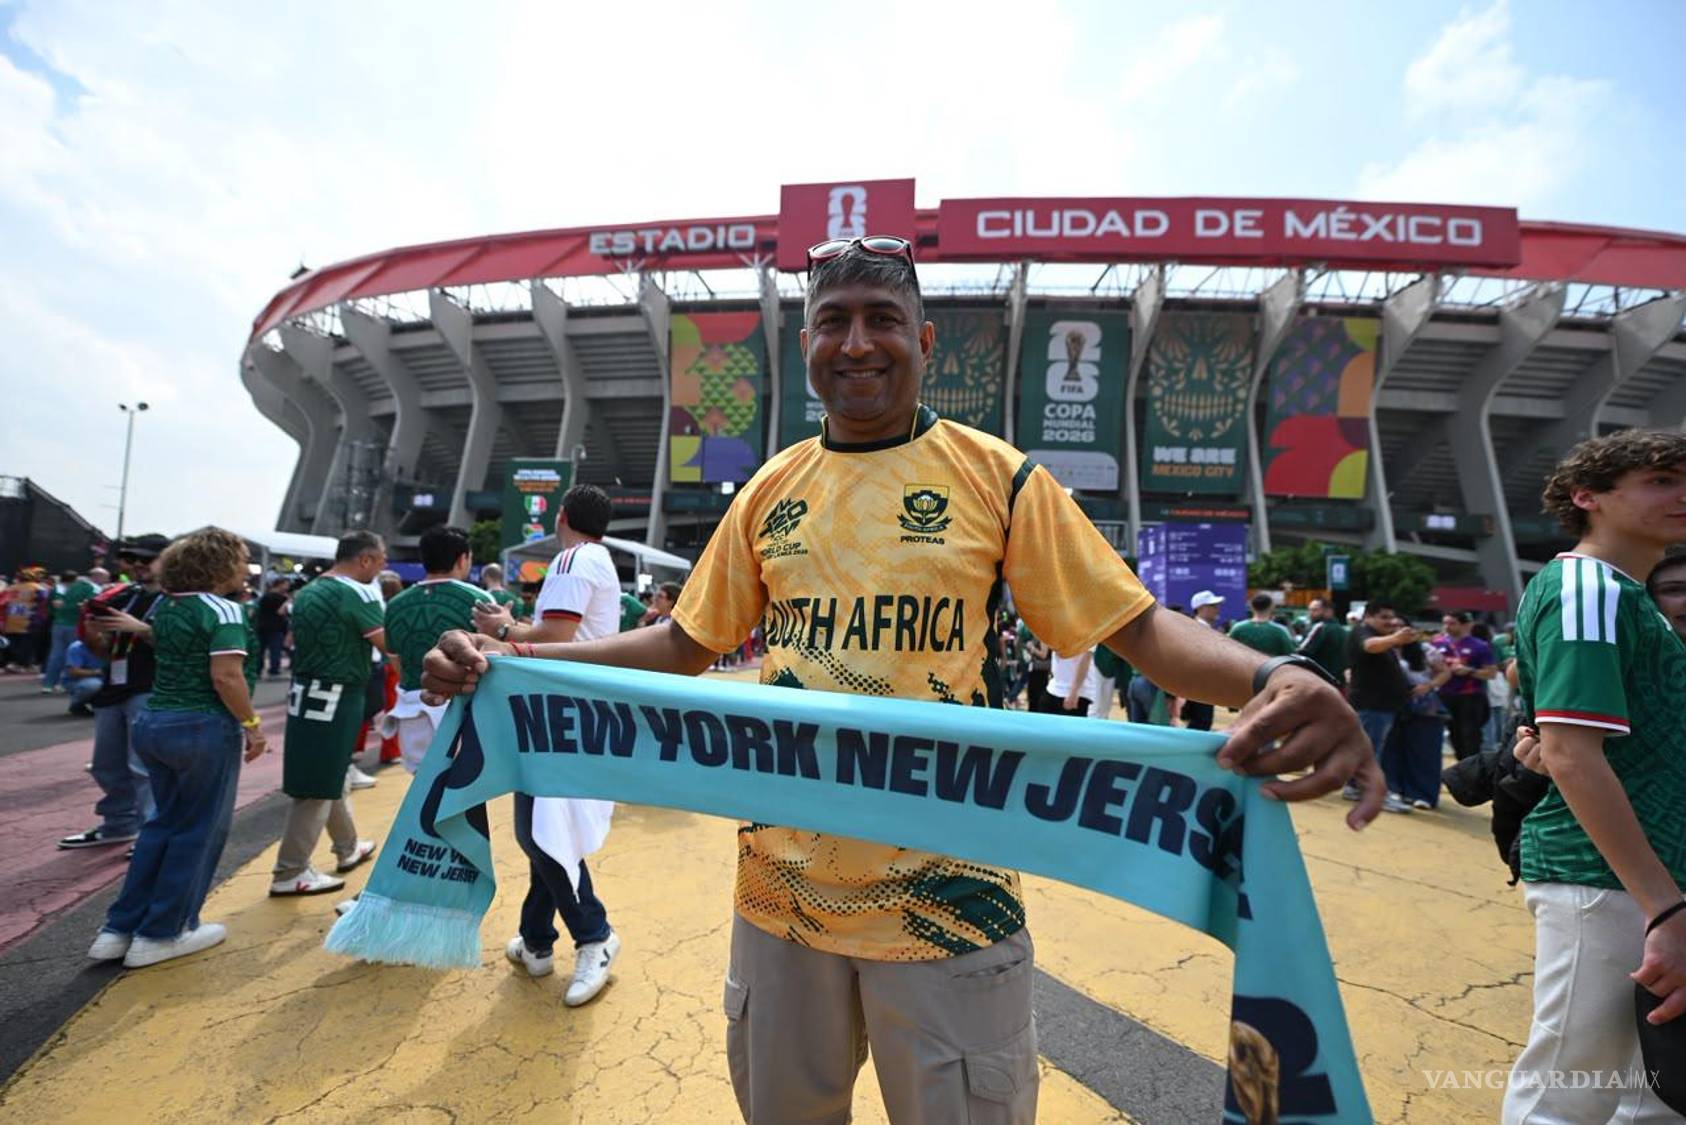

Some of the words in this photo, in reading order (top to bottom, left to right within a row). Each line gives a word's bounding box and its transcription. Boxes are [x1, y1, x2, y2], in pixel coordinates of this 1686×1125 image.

[976, 209, 1169, 238] CIUDAD
[1194, 210, 1264, 238] DE
[1284, 206, 1483, 246] MÉXICO
[589, 224, 756, 255] ESTADIO
[1060, 384, 1085, 394] FIFA
[1044, 404, 1096, 419] COPA
[1043, 419, 1096, 430] MUNDIAL
[1042, 429, 1096, 443] 2026
[783, 541, 802, 552] CUP
[900, 535, 945, 545] PROTEAS
[841, 595, 965, 652] AFRICA
[507, 693, 638, 759] NEW
[640, 705, 820, 780] YORK
[836, 727, 1027, 811] NEW
[404, 837, 448, 862] NEW
[396, 853, 441, 879] NEW
